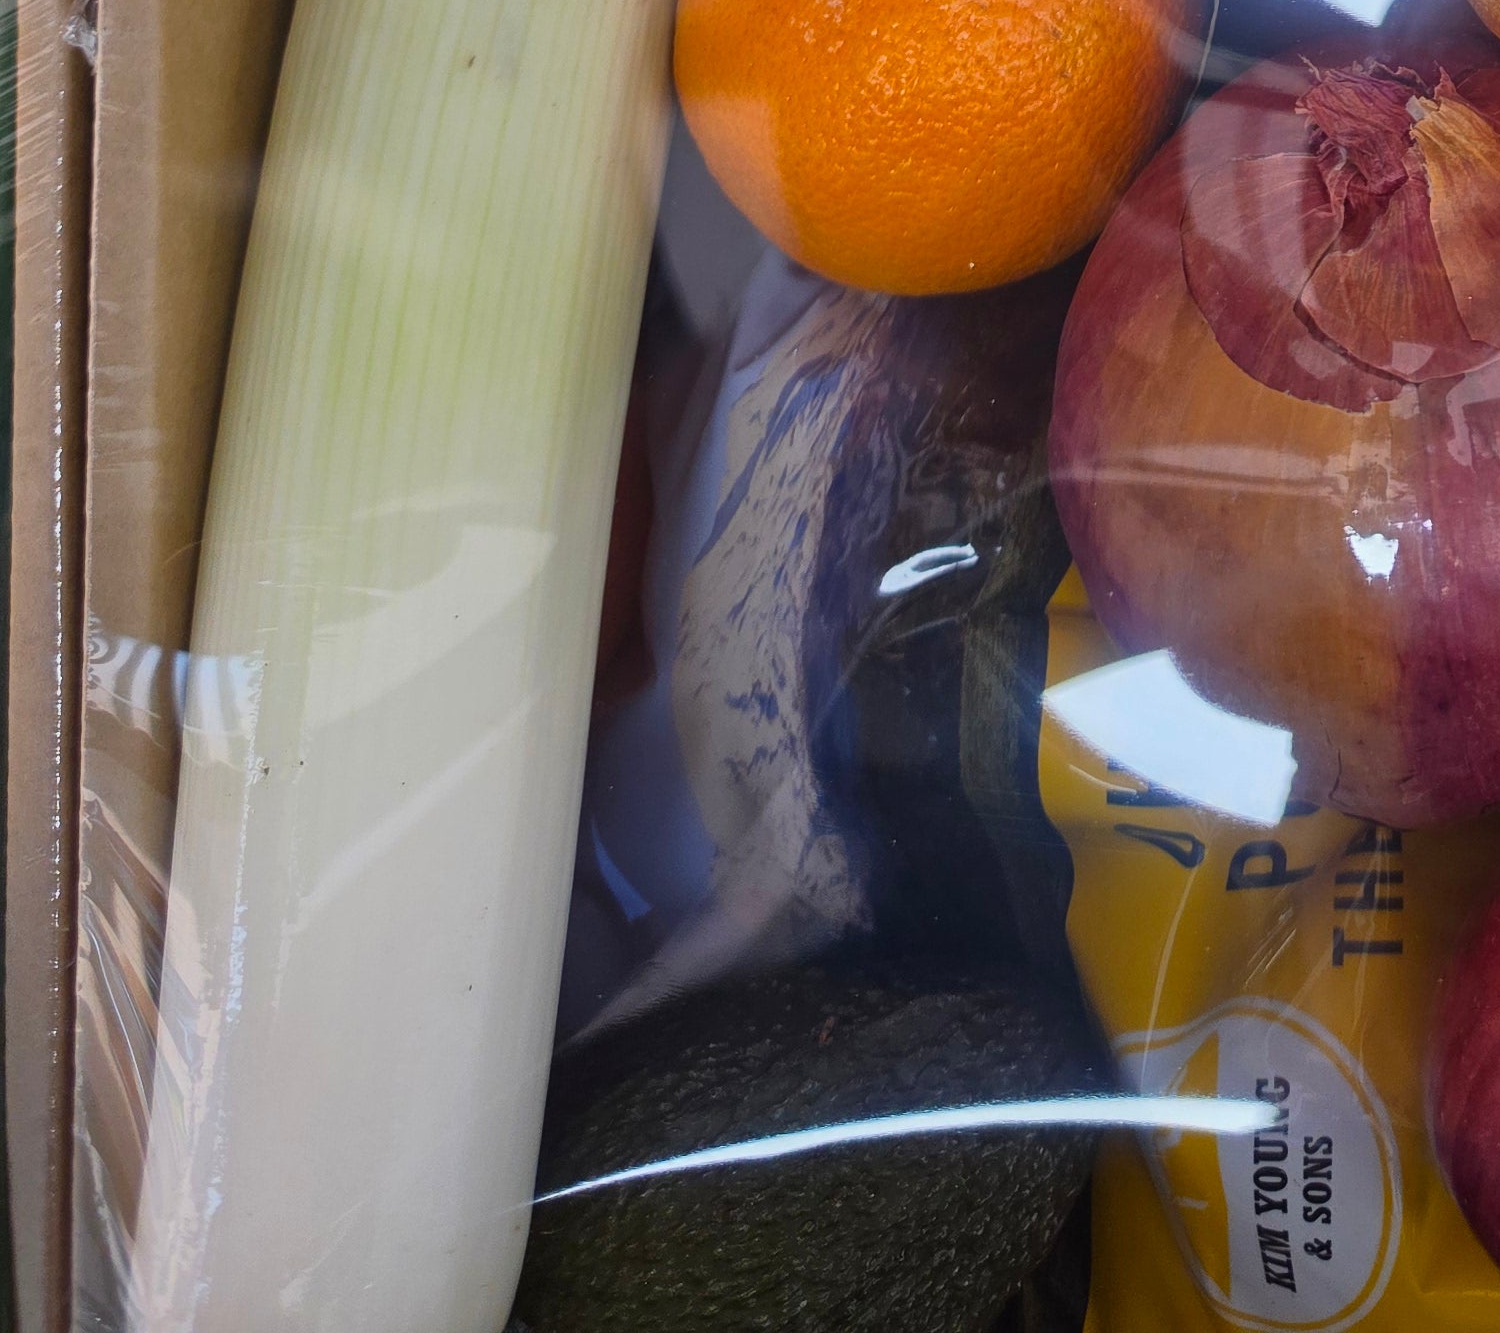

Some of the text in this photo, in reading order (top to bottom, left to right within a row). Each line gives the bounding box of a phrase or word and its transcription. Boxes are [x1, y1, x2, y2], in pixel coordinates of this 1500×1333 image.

[1302, 1136, 1333, 1261] & SONS
[1256, 1223, 1296, 1294] KIM
